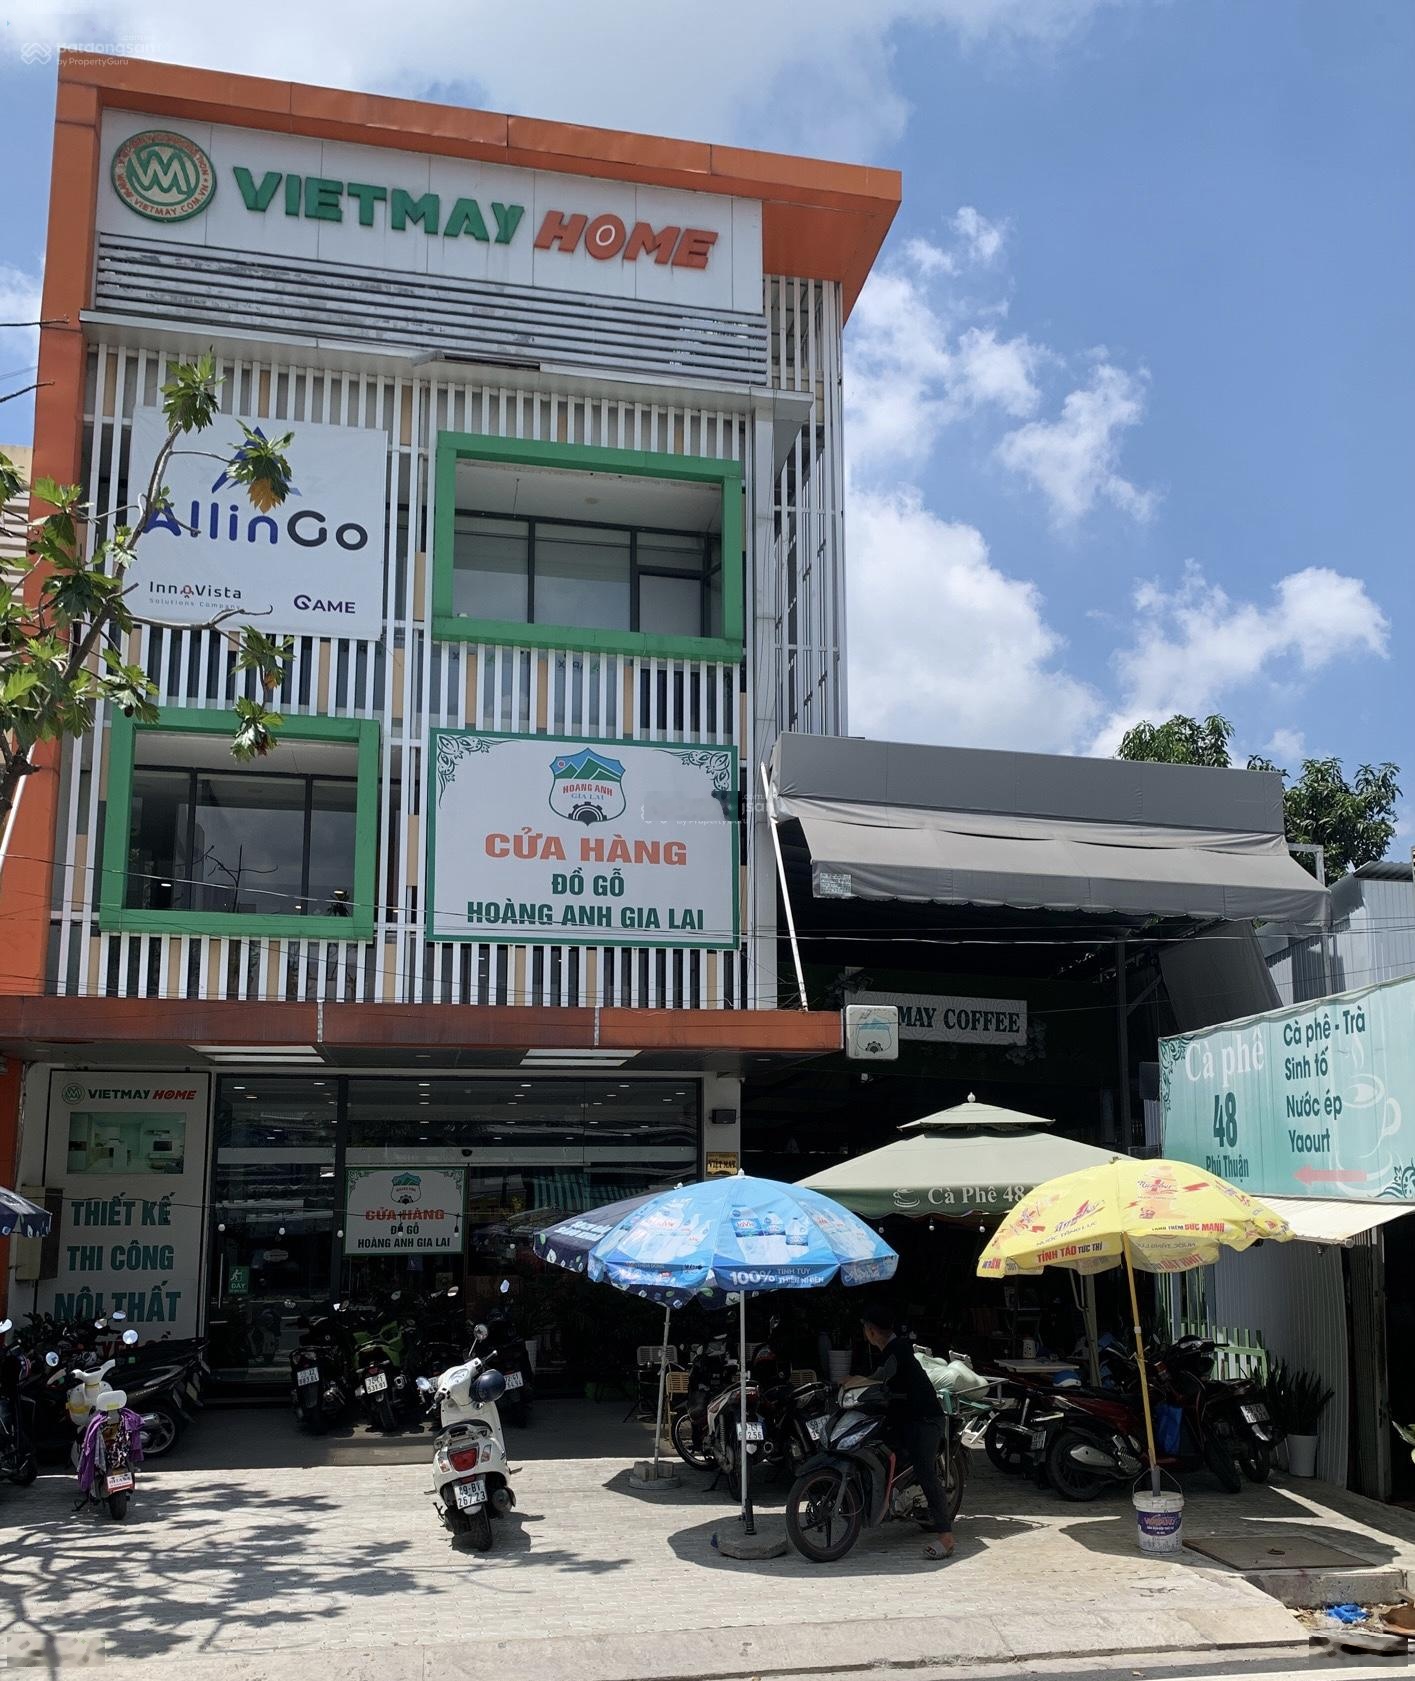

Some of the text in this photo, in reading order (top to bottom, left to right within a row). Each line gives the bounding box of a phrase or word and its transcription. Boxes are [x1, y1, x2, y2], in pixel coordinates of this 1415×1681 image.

[233, 166, 718, 270] VIETMAY HOME
[142, 500, 368, 551] AllinGo
[293, 594, 356, 614] GAME
[594, 784, 613, 797] ANH
[485, 826, 687, 866] CỬA HÀNG
[551, 866, 625, 898] ĐỒ GỖ
[467, 897, 703, 930] HOÀNG ANH GIA LAI
[898, 1005, 1021, 1034] MAY COFFEE
[1283, 1019, 1302, 1047] Cà
[1306, 1013, 1332, 1044] phê
[1343, 1005, 1366, 1036] Trà
[1185, 1025, 1265, 1088] Cà phê
[1284, 1046, 1329, 1081] Sinh tố
[88, 1088, 197, 1100] VIETMAY HOME
[1286, 1088, 1343, 1120] Nước ép
[1213, 1091, 1238, 1148] 48
[1288, 1127, 1331, 1153] Yaourt
[1223, 1153, 1249, 1183] Thuận
[71, 1191, 176, 1226] THIẾT KẾ
[928, 1184, 1025, 1205] Cà Phê 48
[67, 1239, 175, 1271] THI CÔNG
[357, 1237, 450, 1249] HOÀNG ANH GIA LAI
[729, 1268, 777, 1286] 100%
[112, 1280, 182, 1322] THẤT
